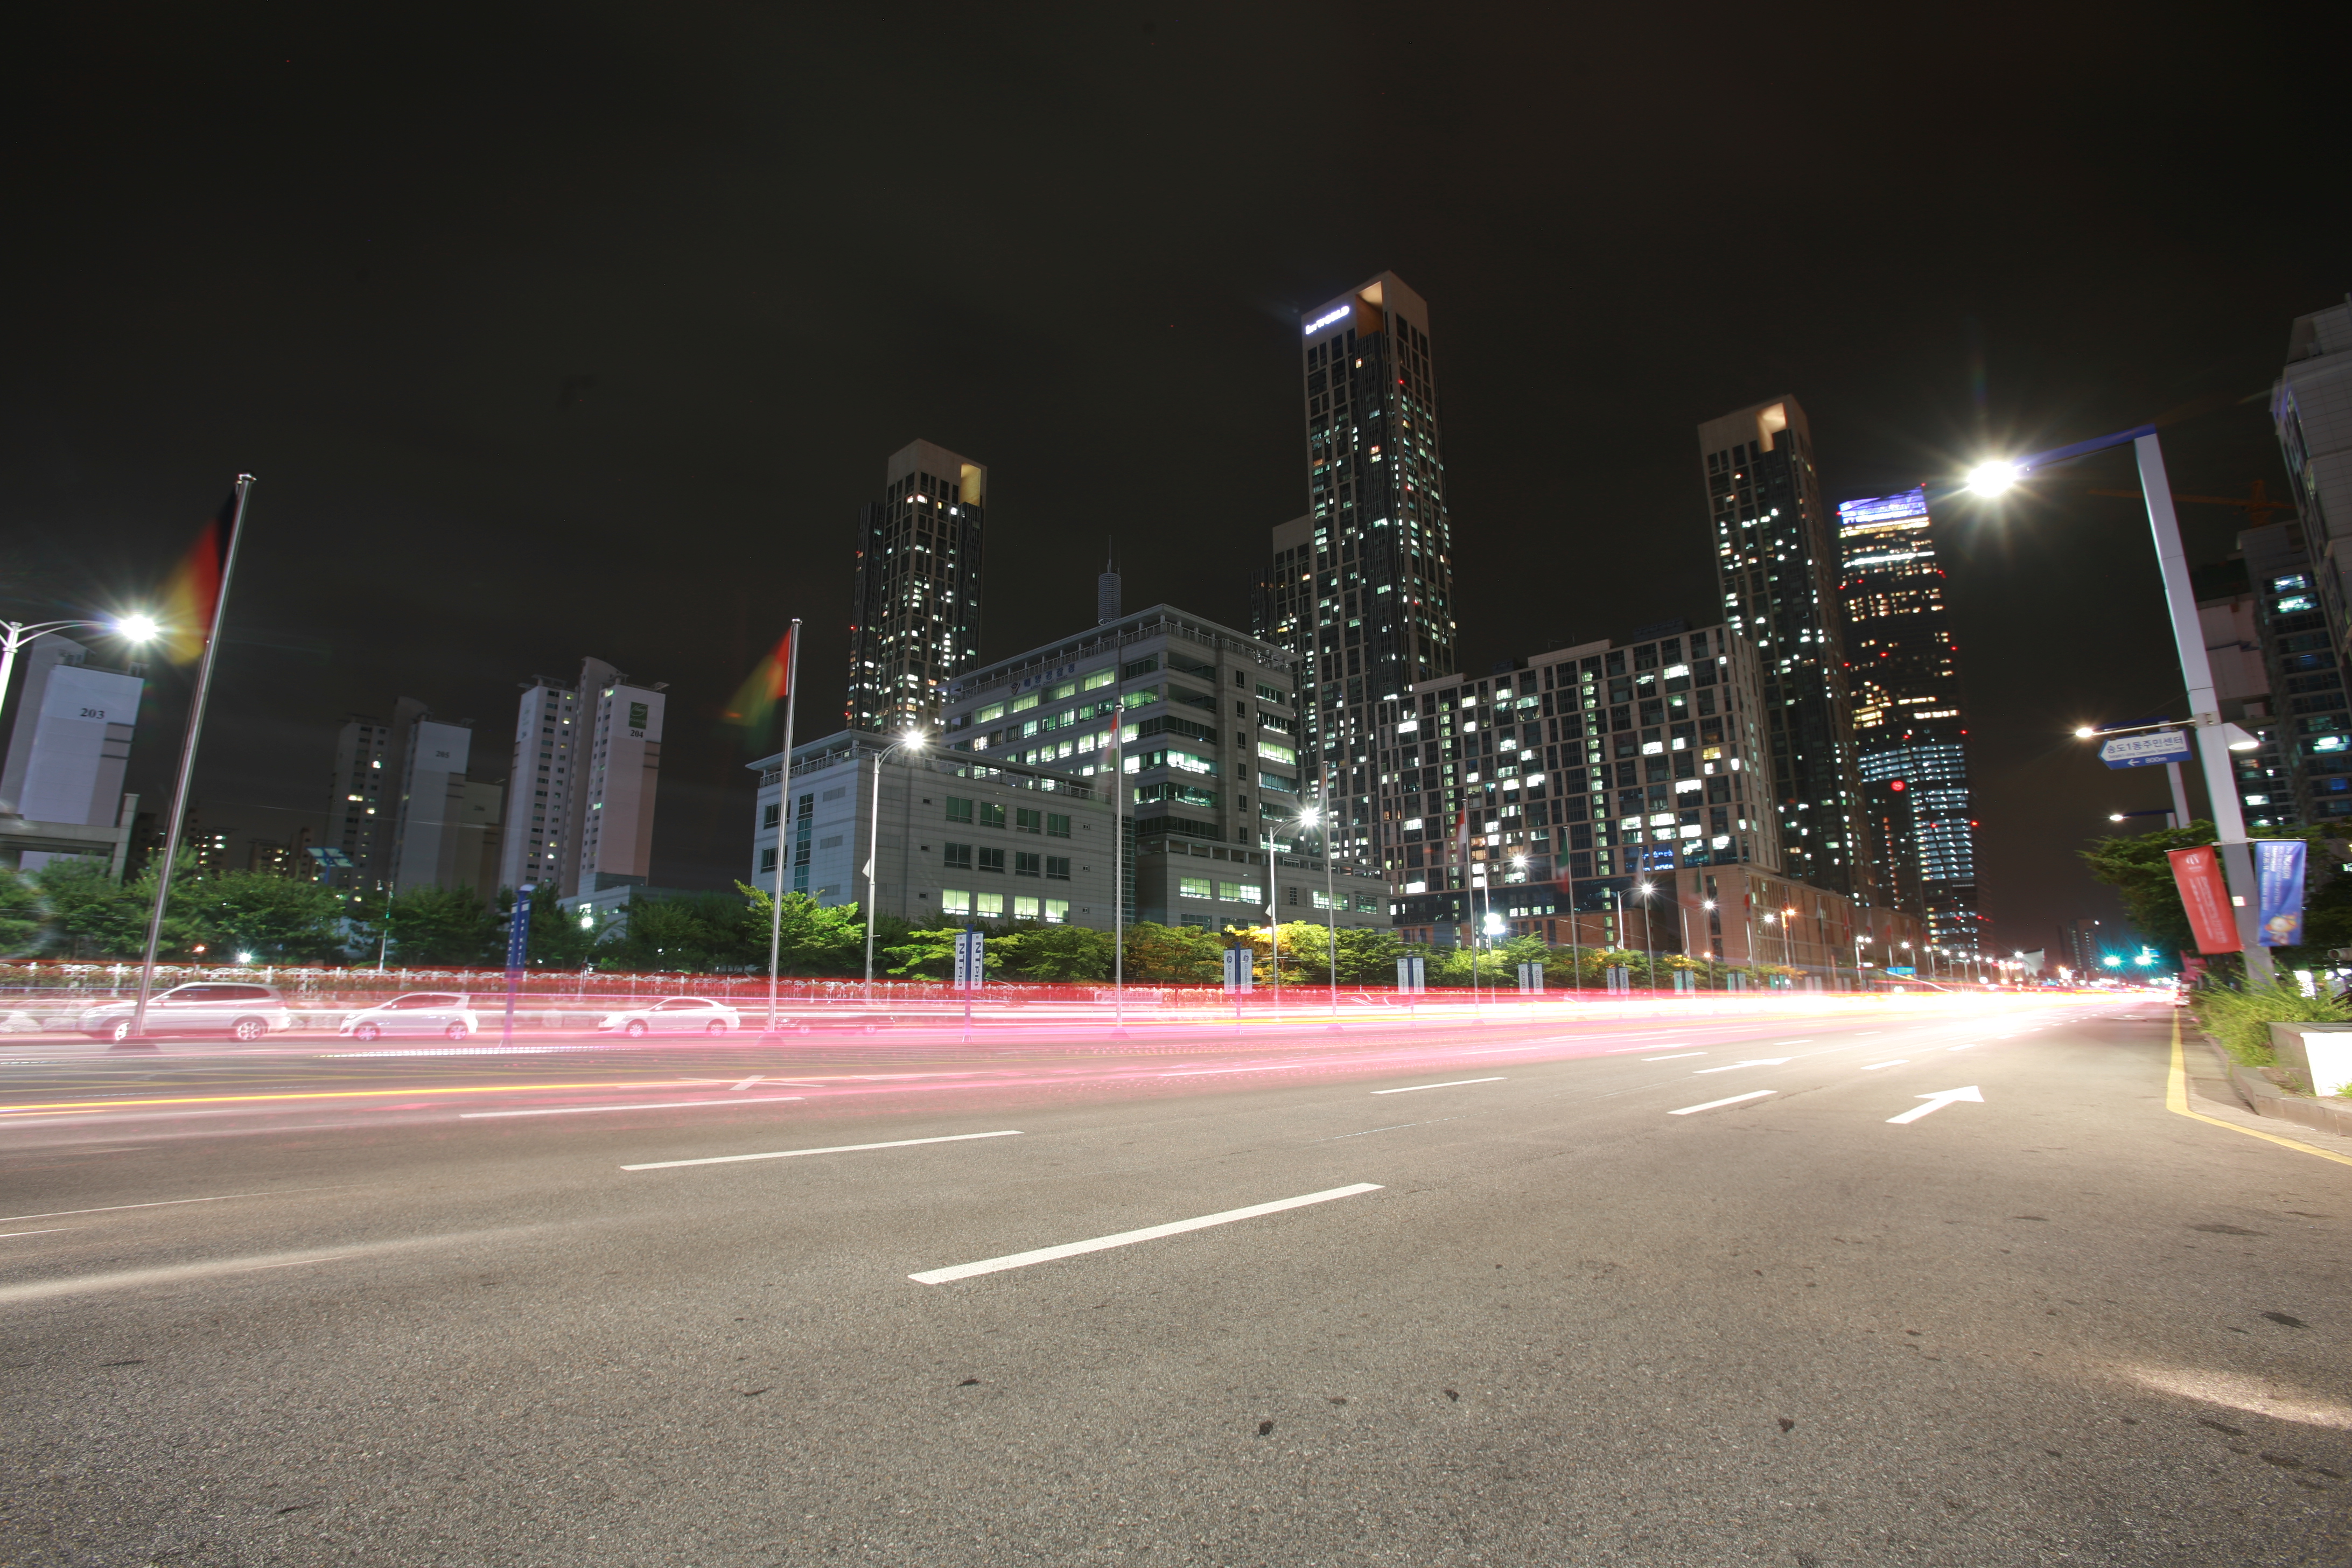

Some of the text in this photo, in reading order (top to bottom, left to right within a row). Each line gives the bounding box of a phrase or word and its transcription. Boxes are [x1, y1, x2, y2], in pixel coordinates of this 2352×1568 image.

[1024, 663, 1075, 687] 해양경찰청
[80, 708, 105, 719] 203
[630, 729, 643, 738] 204
[2106, 736, 2184, 754] 송도1동주민센터
